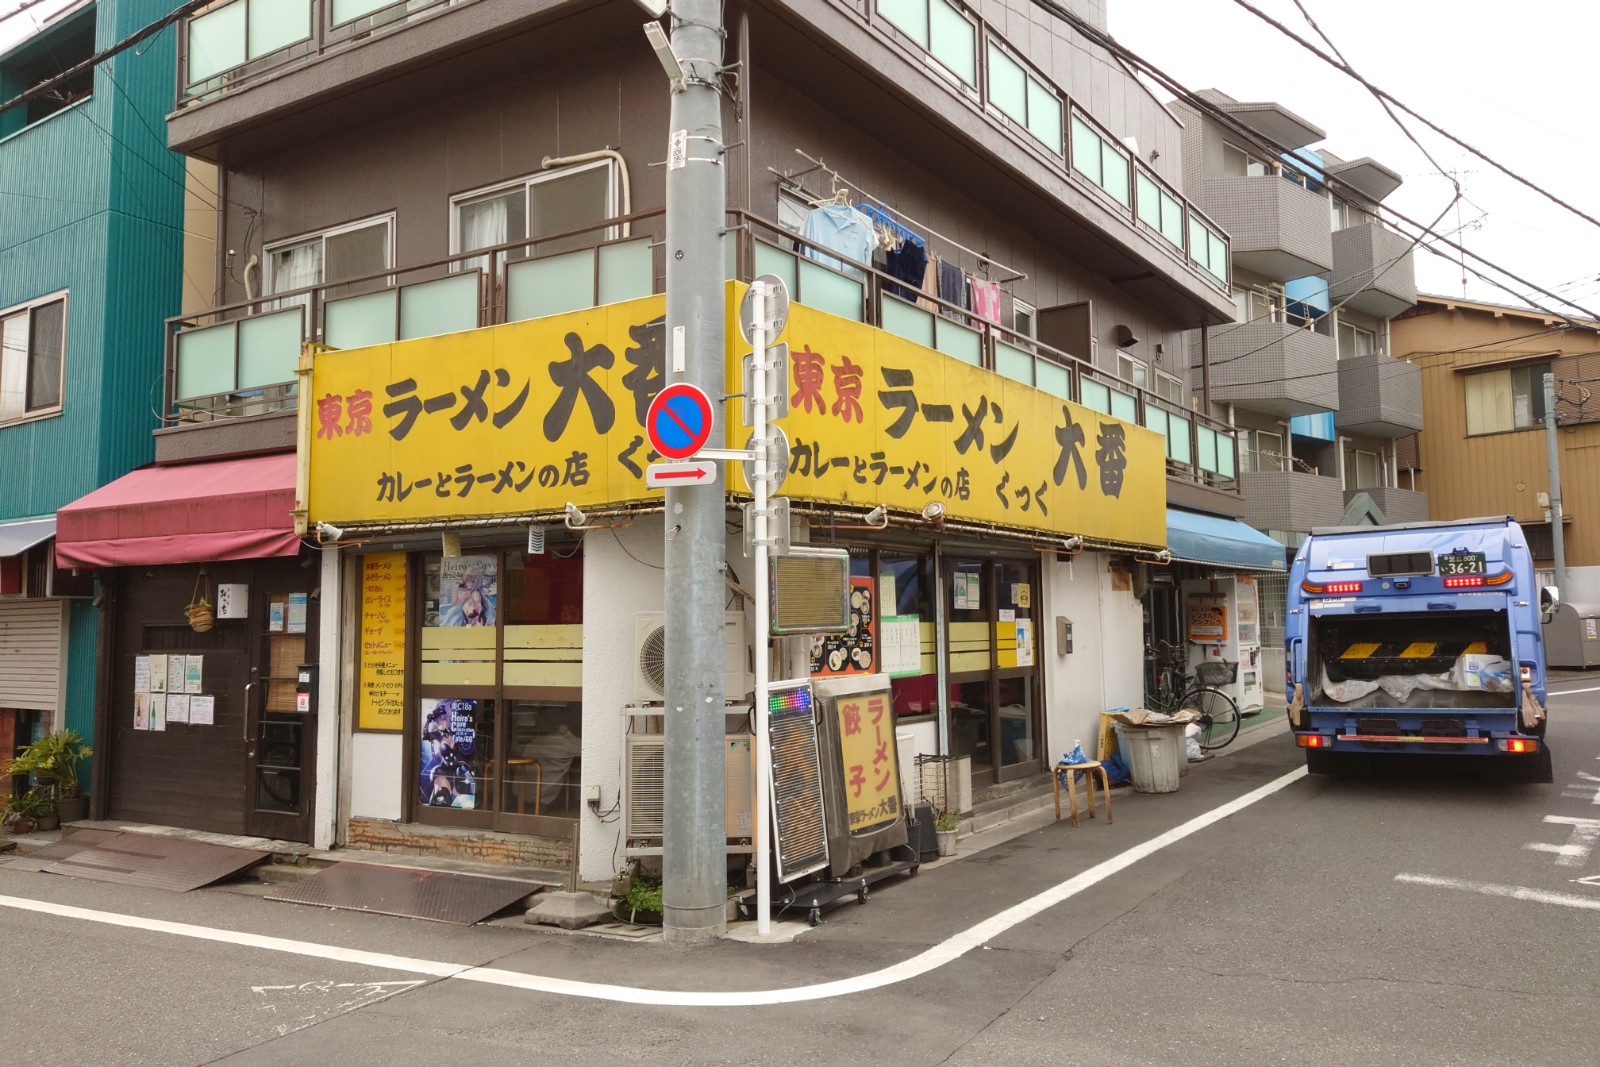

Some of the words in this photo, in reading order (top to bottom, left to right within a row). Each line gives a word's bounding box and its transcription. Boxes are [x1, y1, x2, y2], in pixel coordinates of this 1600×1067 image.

[316, 389, 373, 440] 東京
[383, 368, 531, 441] ラーメン
[790, 344, 864, 424] 東京
[877, 366, 1019, 464] ラーメン
[1052, 405, 1127, 499] 大番
[376, 451, 590, 502] カレーとラーメンの店
[789, 437, 971, 501] カレーとラーメンの店
[1448, 561, 1483, 574] 36-21
[842, 703, 866, 798] 餃子
[867, 698, 891, 792] ラーメン
